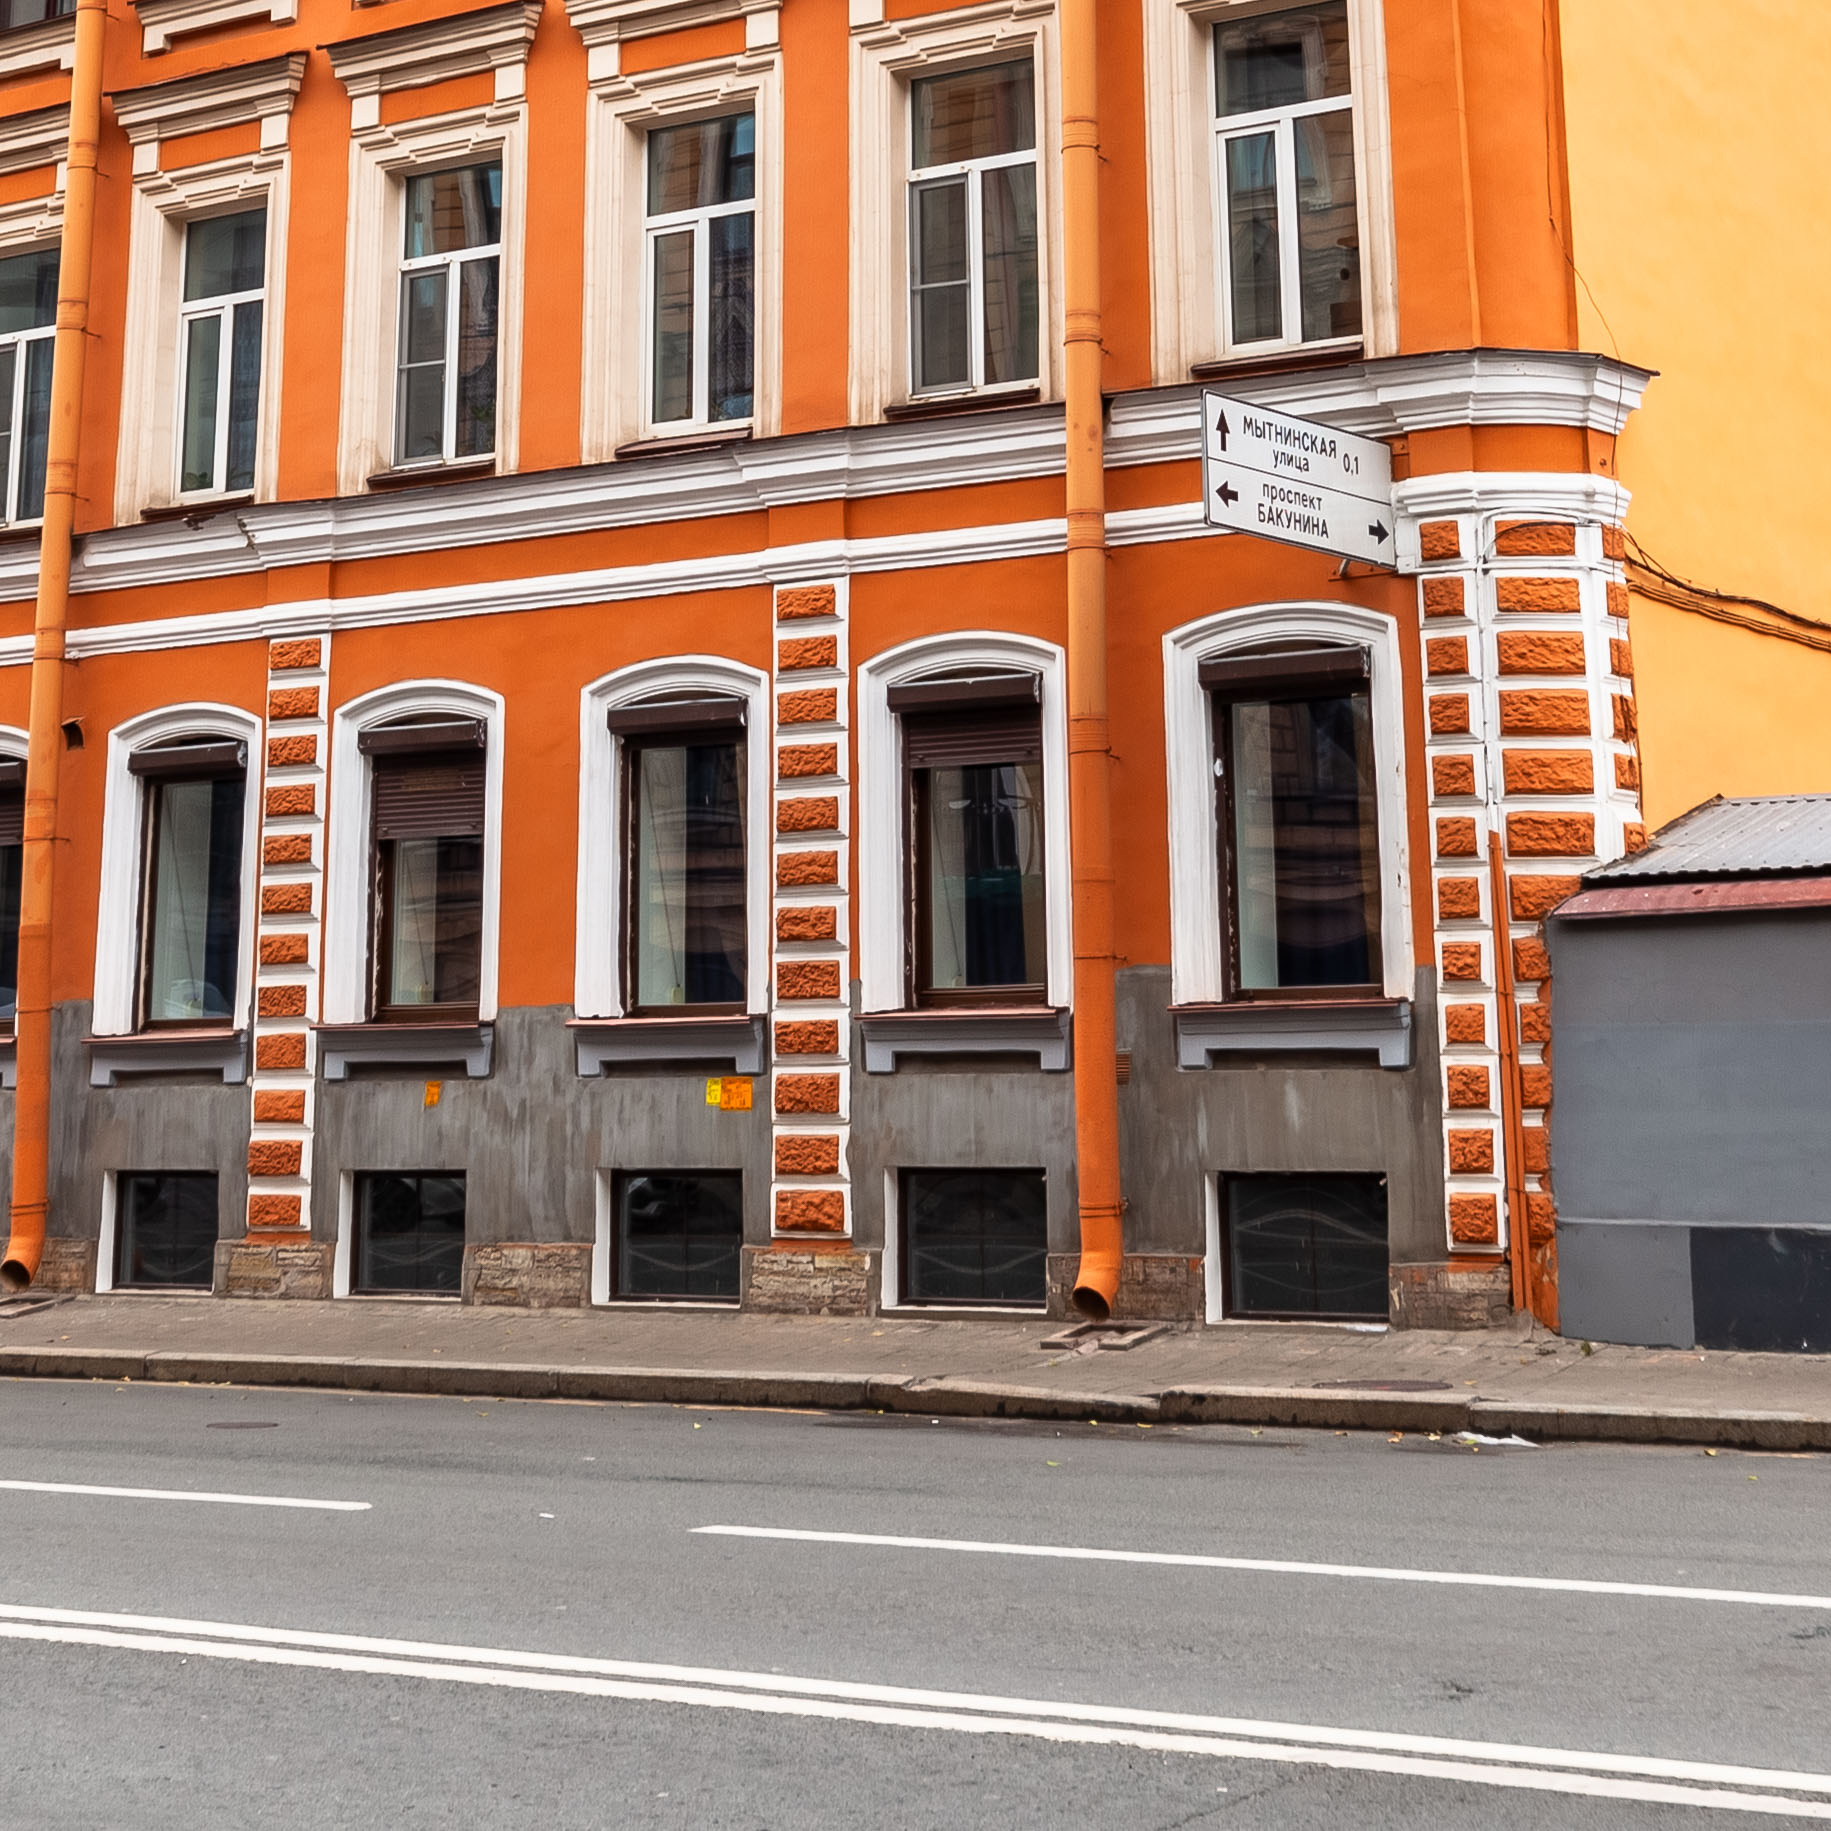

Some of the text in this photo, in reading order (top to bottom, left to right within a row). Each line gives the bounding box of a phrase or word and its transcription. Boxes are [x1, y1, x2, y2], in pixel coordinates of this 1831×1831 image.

[1243, 415, 1336, 459] МЫТНИНСКАЯ
[1273, 449, 1309, 472] улица
[1262, 483, 1322, 511] проспект
[1258, 503, 1329, 538] БАКУНИНА
